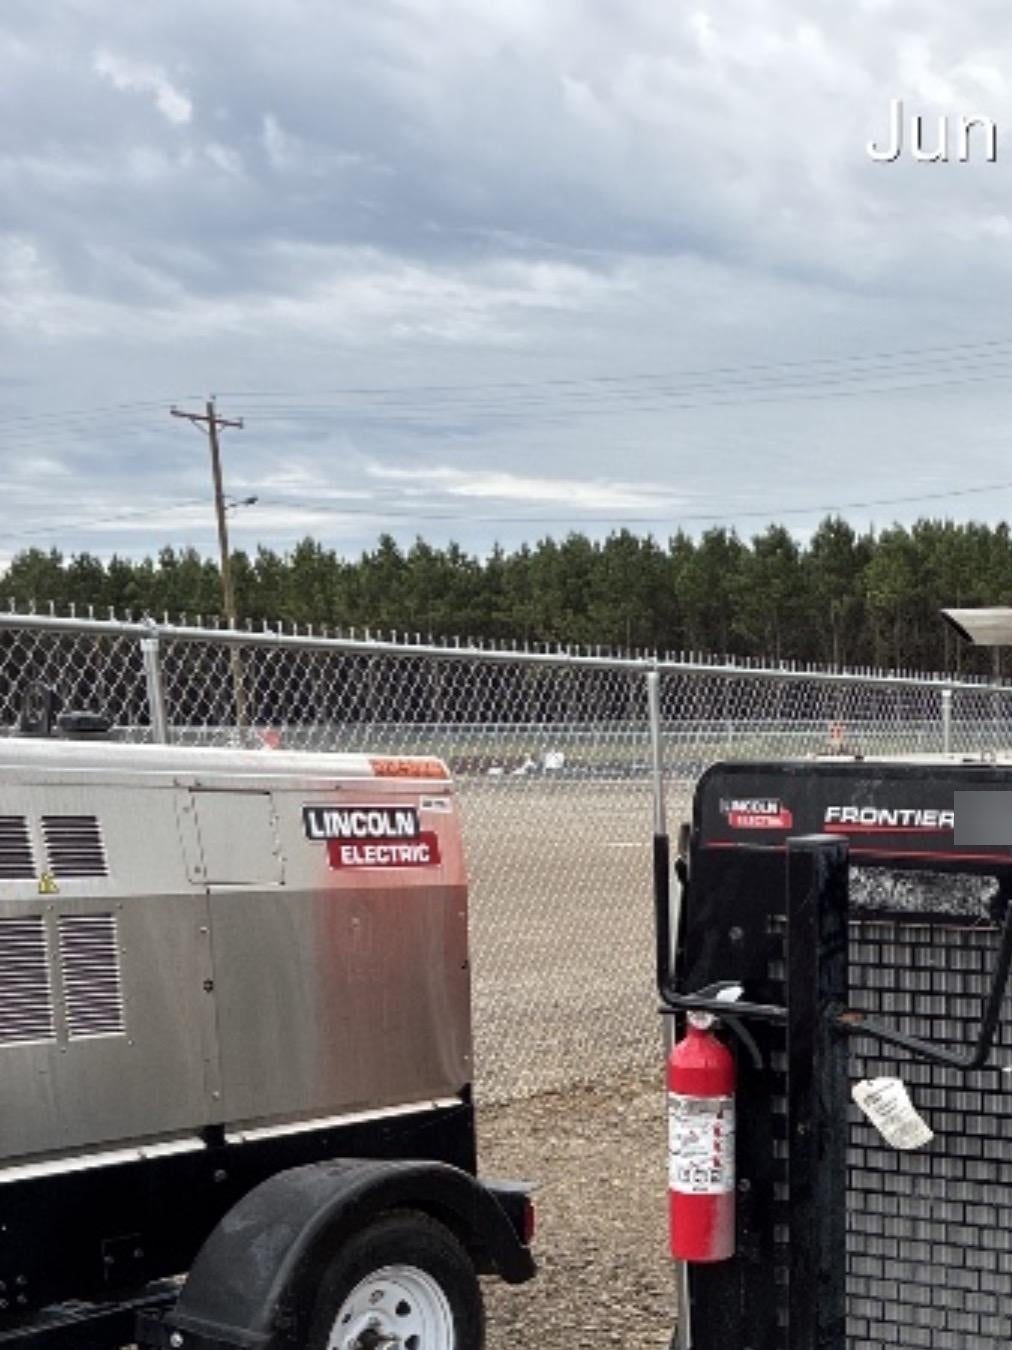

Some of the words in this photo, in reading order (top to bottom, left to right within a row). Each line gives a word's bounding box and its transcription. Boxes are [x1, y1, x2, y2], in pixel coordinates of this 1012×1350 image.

[307, 809, 416, 838] LINCOLN
[824, 805, 955, 829] FRONTIER
[339, 842, 431, 865] ELECTRIC
